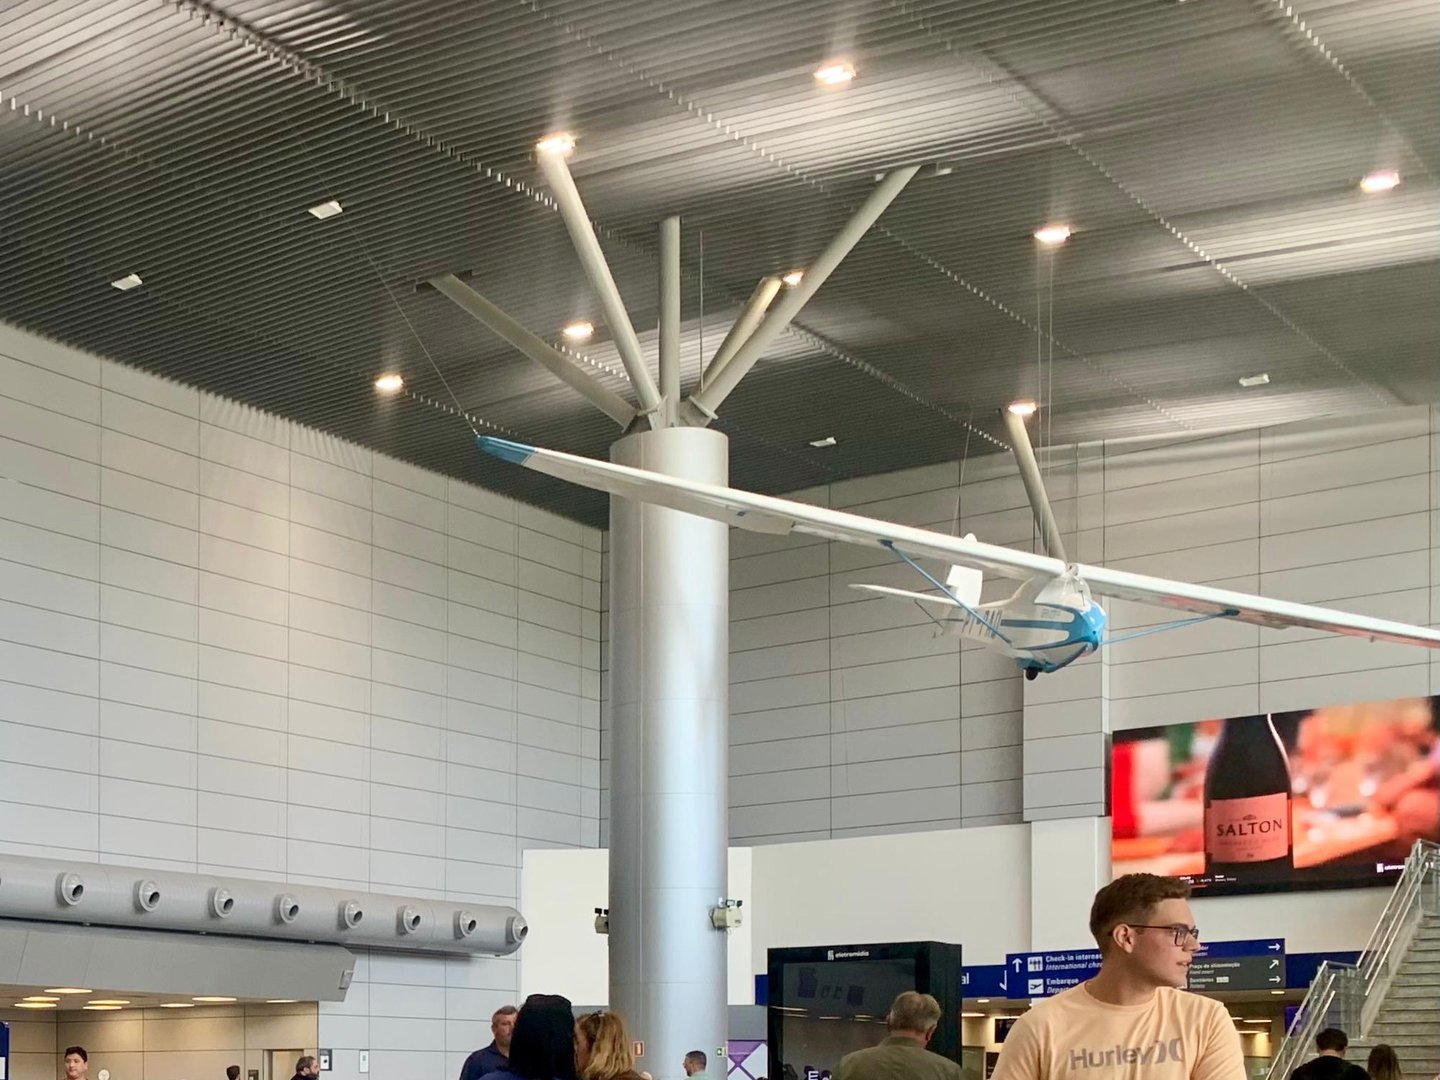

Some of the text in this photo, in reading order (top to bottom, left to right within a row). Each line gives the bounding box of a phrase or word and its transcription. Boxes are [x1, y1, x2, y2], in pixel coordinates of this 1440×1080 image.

[1216, 818, 1282, 837] SALTON
[1045, 953, 1103, 963] Check-in internac
[1045, 962, 1087, 971] International
[1046, 978, 1079, 986] Embarque
[1069, 1044, 1154, 1070] Hurley
